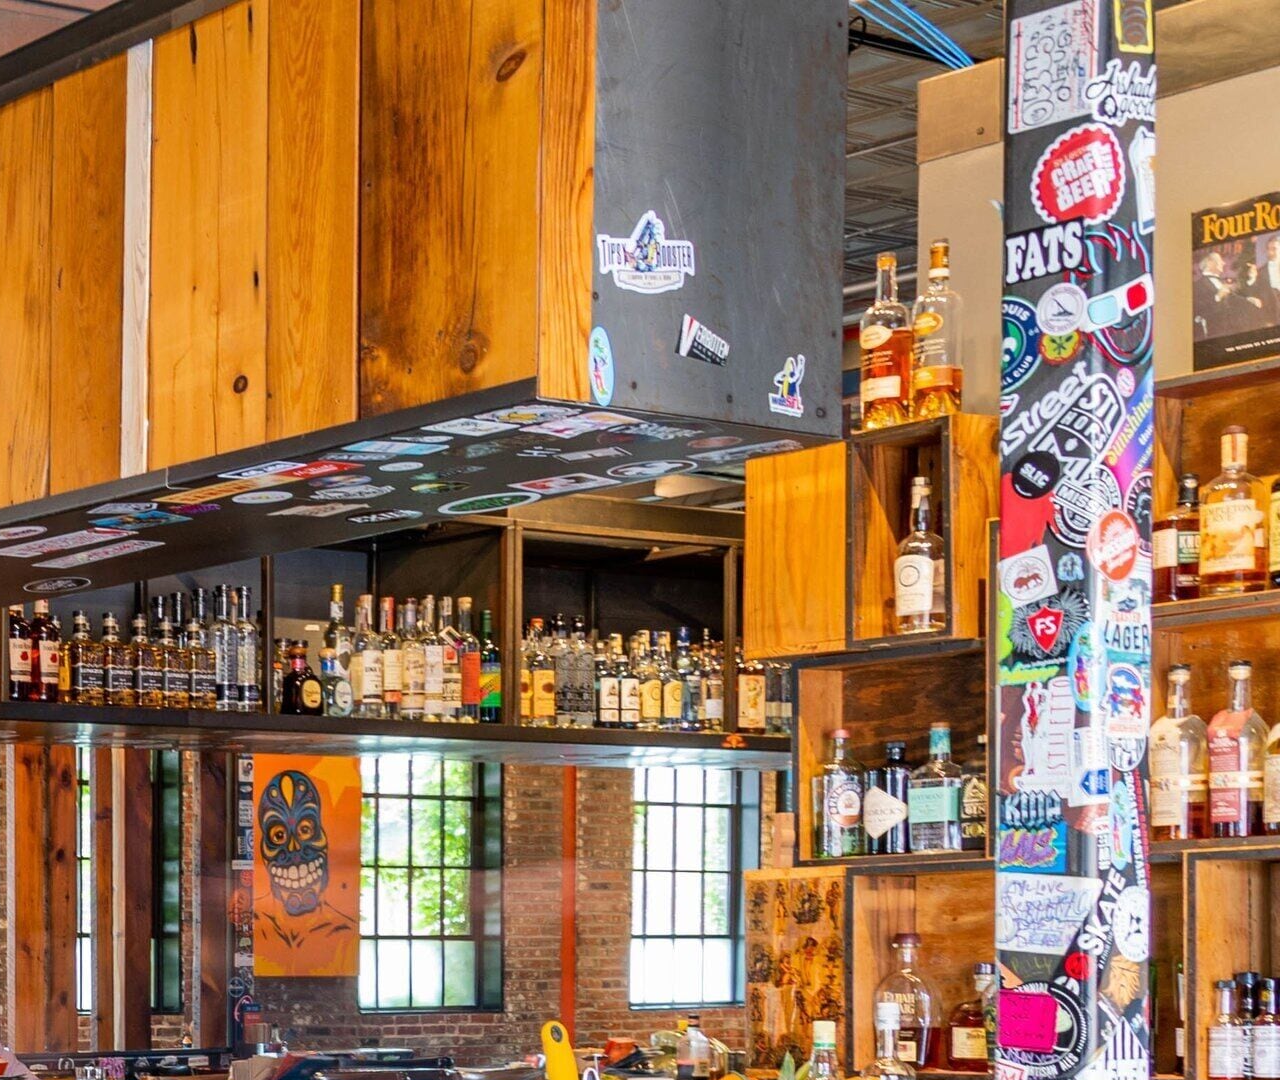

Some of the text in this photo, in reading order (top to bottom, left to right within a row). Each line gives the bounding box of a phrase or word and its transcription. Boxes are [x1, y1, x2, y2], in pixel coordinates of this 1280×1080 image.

[1051, 141, 1116, 188] CRAFT
[1056, 167, 1114, 212] BEER
[1202, 210, 1255, 244] Four
[1005, 221, 1085, 285] FATS
[1013, 355, 1034, 378] CLUB
[1078, 382, 1120, 434] STL
[1034, 615, 1057, 636] FS
[1104, 619, 1151, 651] LAGER
[1077, 867, 1127, 957] SKATE
